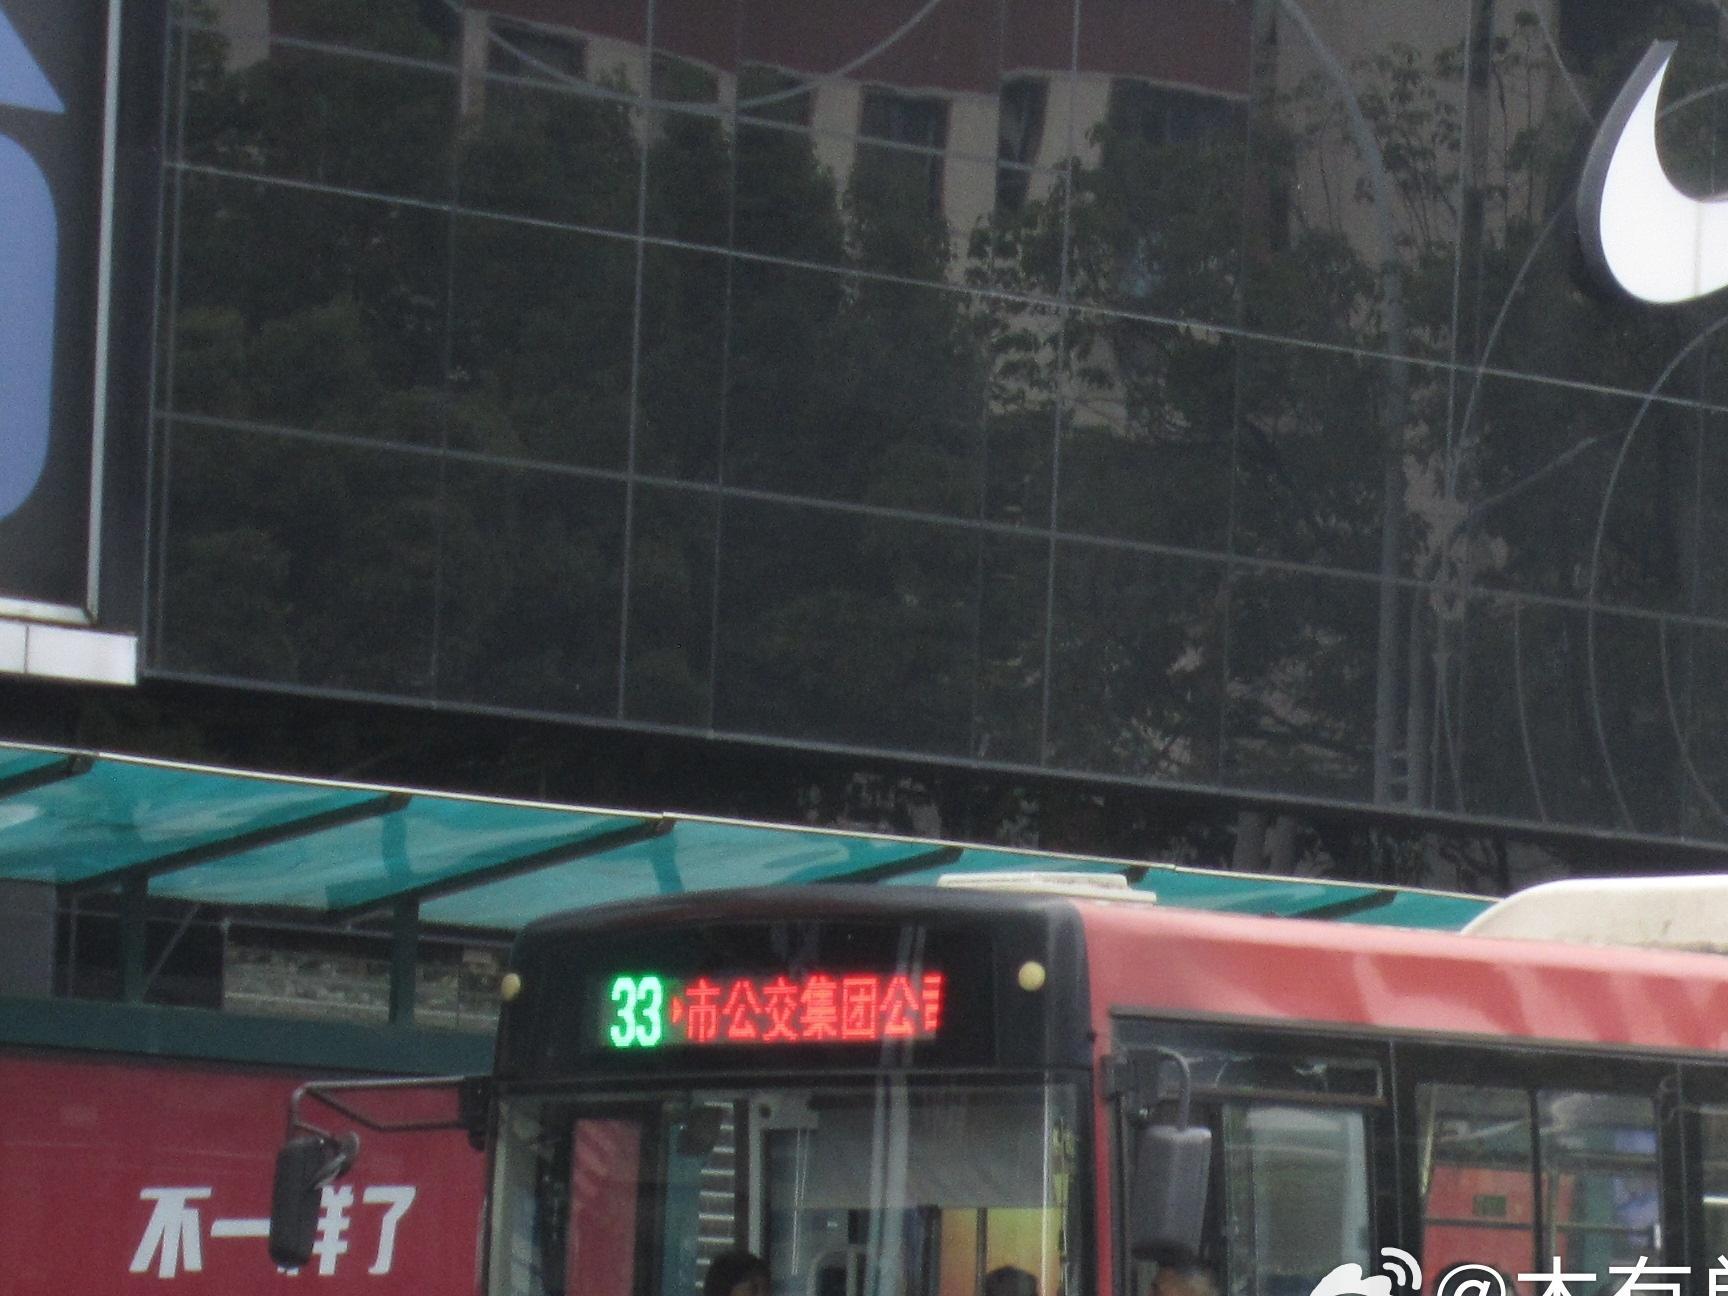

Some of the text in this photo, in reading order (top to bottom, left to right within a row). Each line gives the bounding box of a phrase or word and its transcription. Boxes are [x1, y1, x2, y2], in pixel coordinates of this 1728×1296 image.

[610, 976, 663, 1047] 33
[129, 1185, 417, 1279] 不一样了
